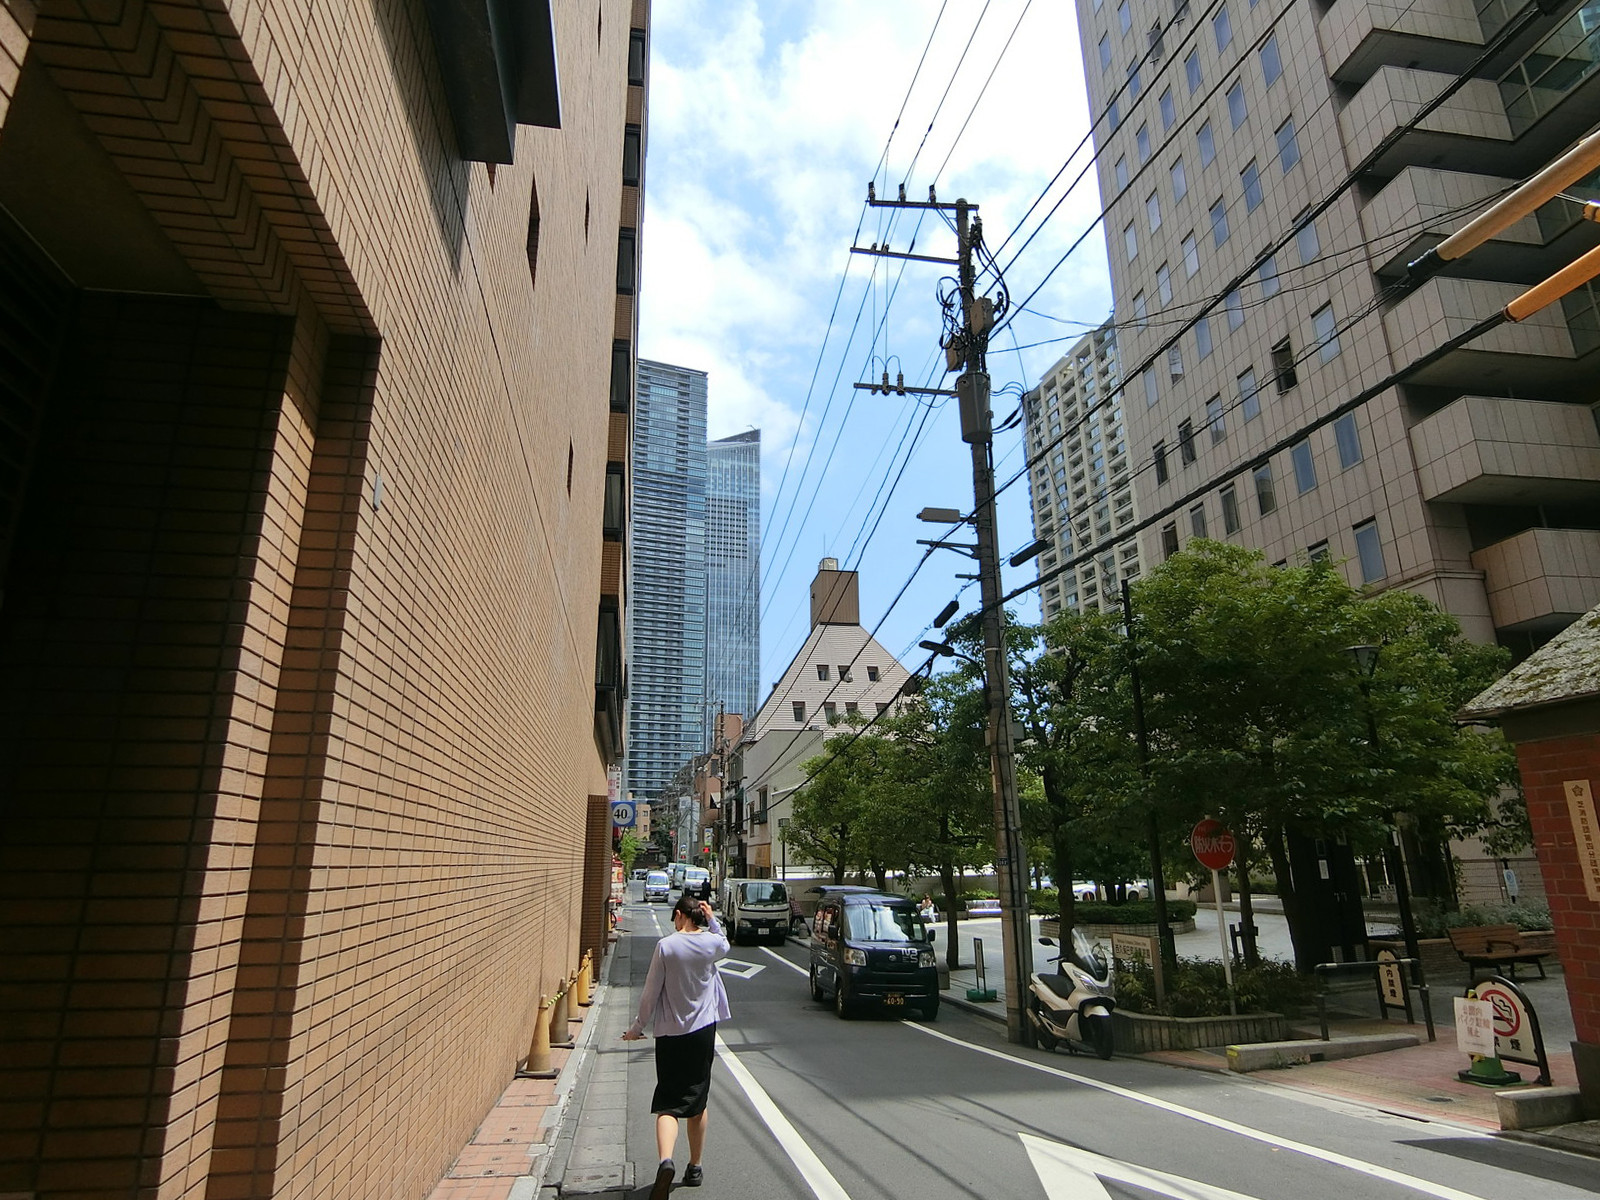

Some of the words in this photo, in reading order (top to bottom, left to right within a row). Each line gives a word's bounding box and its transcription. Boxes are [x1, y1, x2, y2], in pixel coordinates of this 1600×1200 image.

[613, 809, 628, 819] 40
[1193, 835, 1234, 854] 防火水そう
